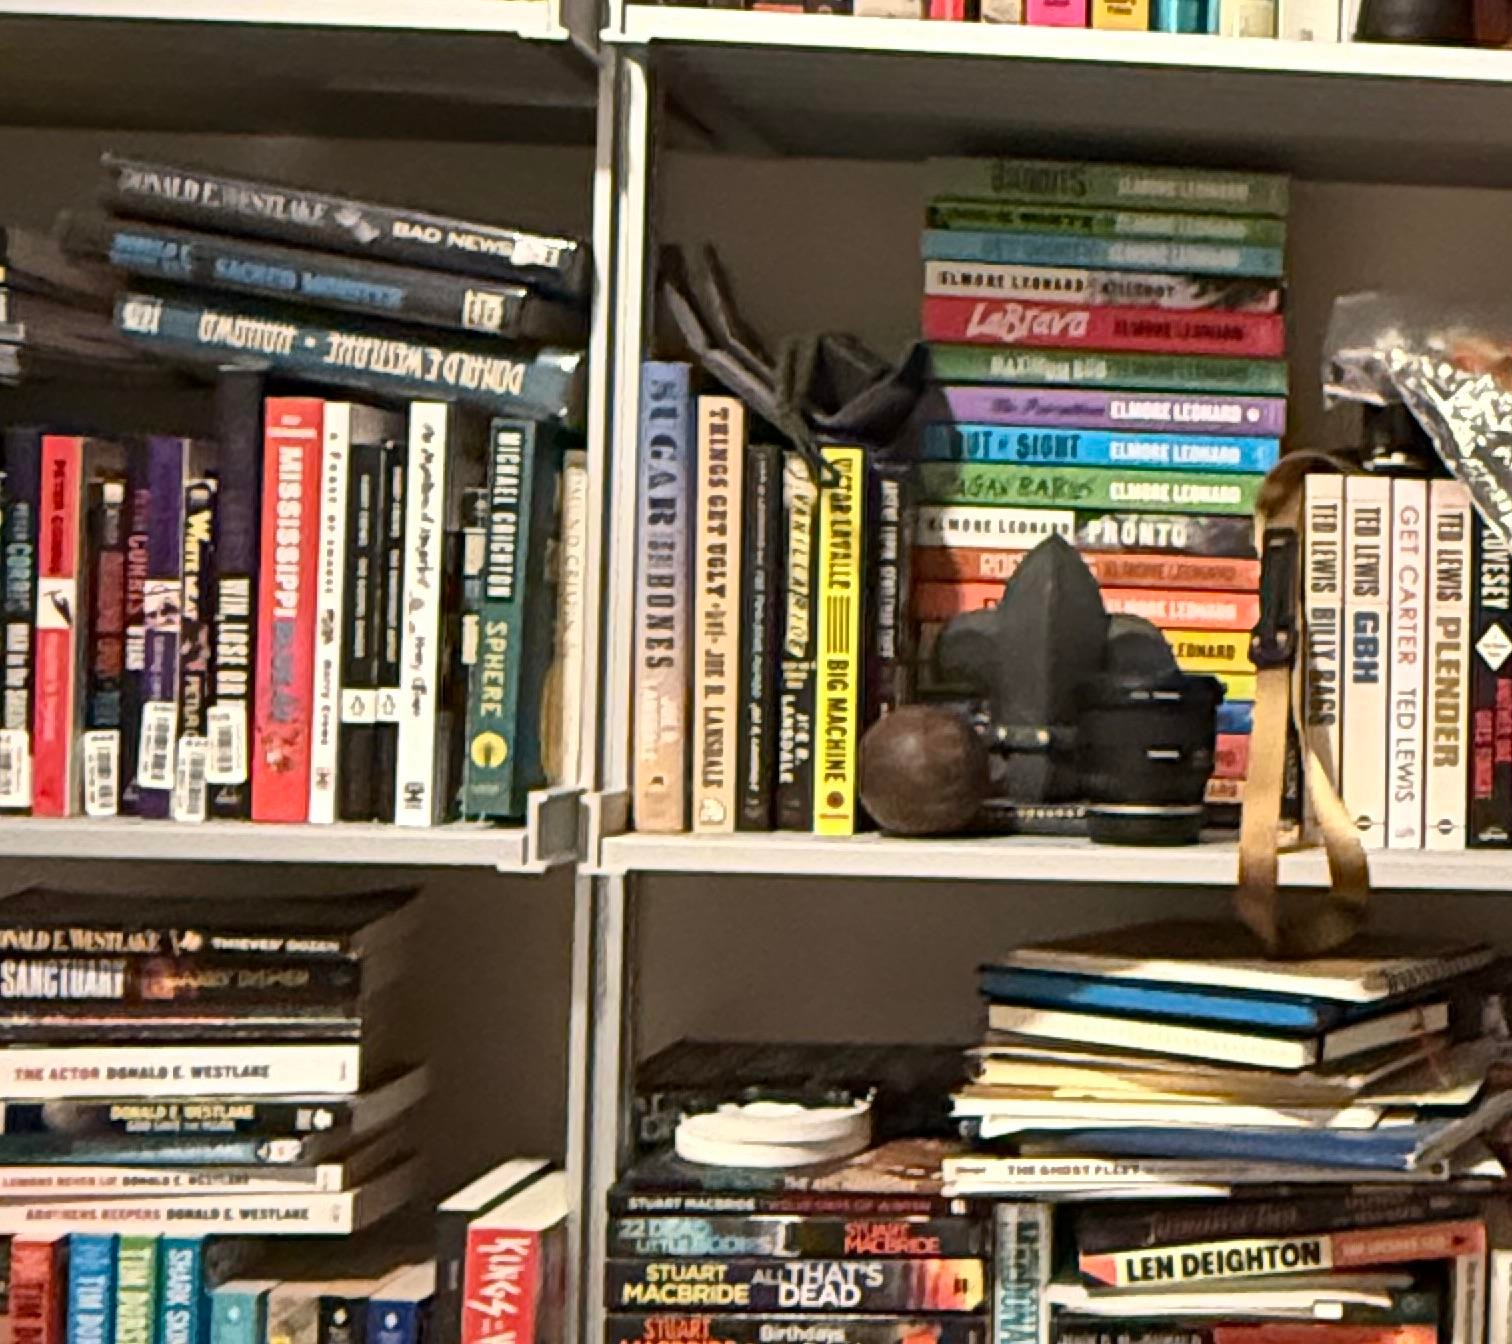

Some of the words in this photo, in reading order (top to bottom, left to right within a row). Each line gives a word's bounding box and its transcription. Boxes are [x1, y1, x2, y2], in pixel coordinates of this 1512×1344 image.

[966, 304, 1090, 338] LaBrava
[494, 431, 522, 506] MICHAEL
[272, 445, 304, 619] MISSISSIPPI
[1089, 520, 1188, 546] PRONTO
[1398, 505, 1419, 553] GET
[488, 512, 516, 598] CRICHTON
[1397, 565, 1418, 666] CARTER
[480, 622, 509, 719] SPHERE
[1351, 611, 1379, 684] GBH
[829, 658, 847, 692] BIG
[1434, 617, 1461, 768] PLENDER
[1397, 688, 1415, 731] TED
[824, 698, 847, 783] MACHINE
[1394, 737, 1414, 803] LEWIS
[1, 962, 126, 998] SANCTUARY
[468, 1234, 532, 1317] KINGS
[645, 1264, 729, 1283] STUART
[781, 1261, 884, 1288] THAT'S
[1127, 1250, 1174, 1282] LEN
[1181, 1243, 1321, 1277] DEIGHTON
[621, 1284, 749, 1306] MACBRIDE
[779, 1285, 862, 1308] DEAD
